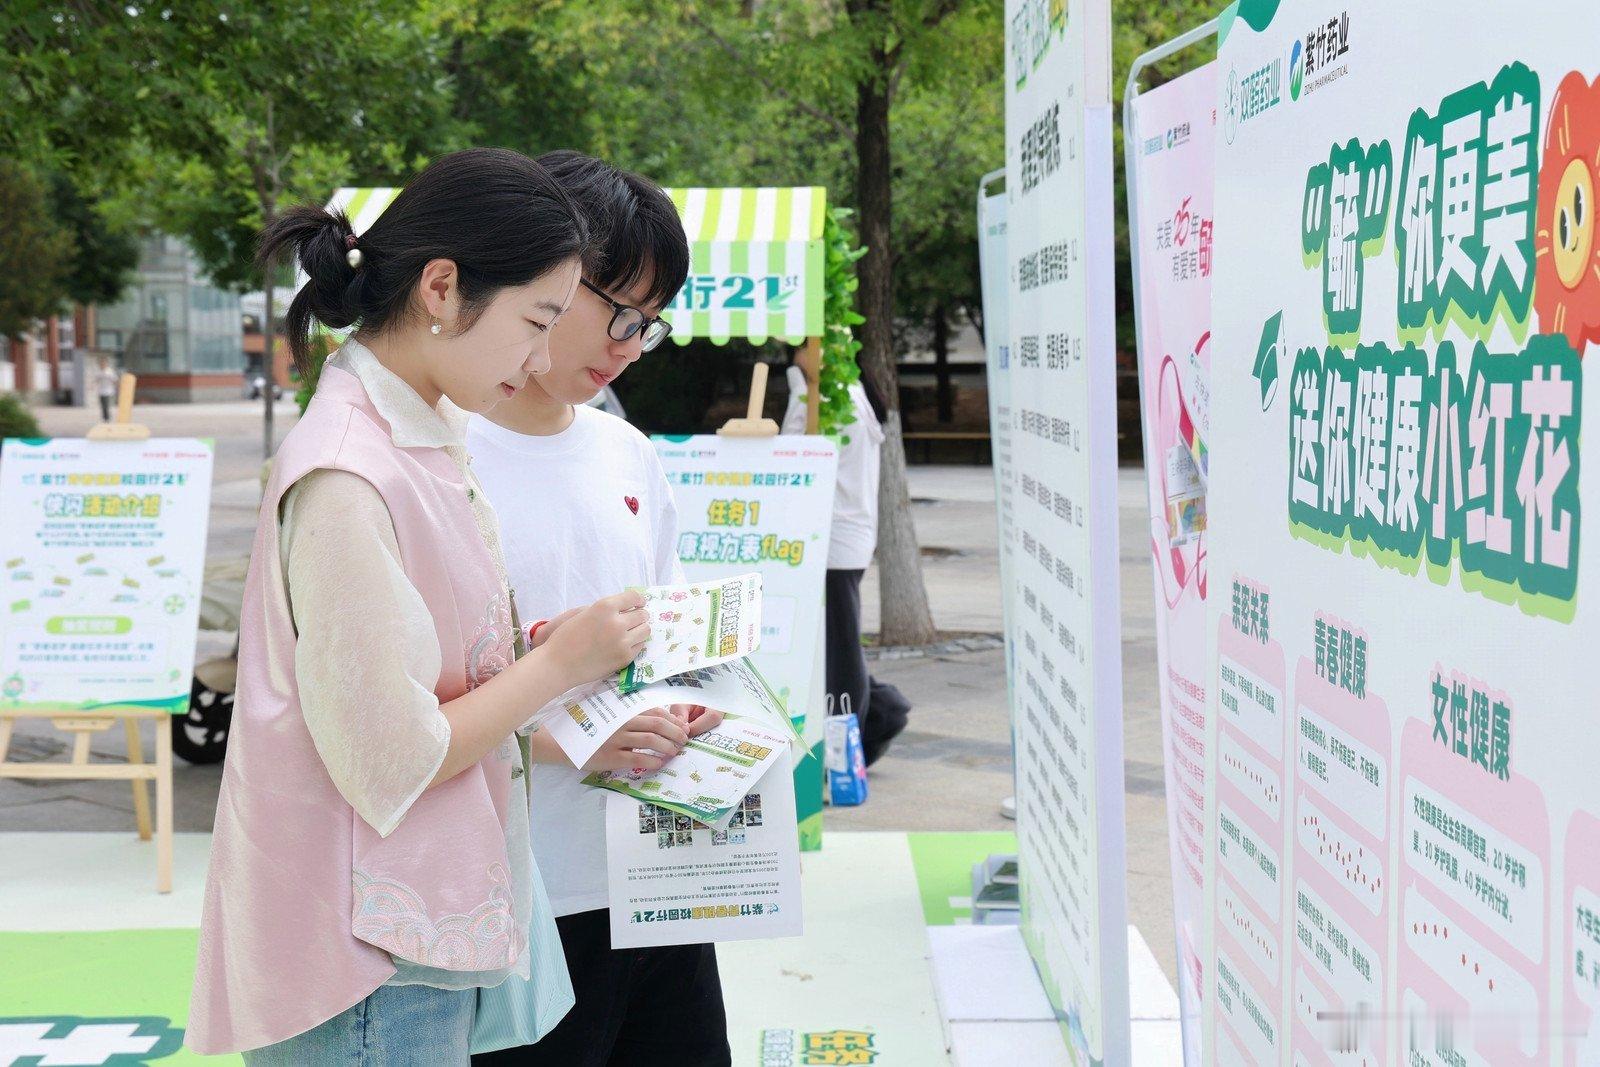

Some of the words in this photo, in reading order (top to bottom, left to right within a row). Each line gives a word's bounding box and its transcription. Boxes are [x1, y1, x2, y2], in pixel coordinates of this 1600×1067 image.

[1305, 11, 1350, 77] 紫竹药业
[1239, 58, 1281, 124] 双鹤药业
[668, 274, 799, 311] 行21st
[1291, 363, 1575, 570] 送你健康小红花
[1232, 578, 1269, 645] 亲密关系
[1314, 617, 1367, 700] 青春健康
[1431, 671, 1511, 783] 女性健康
